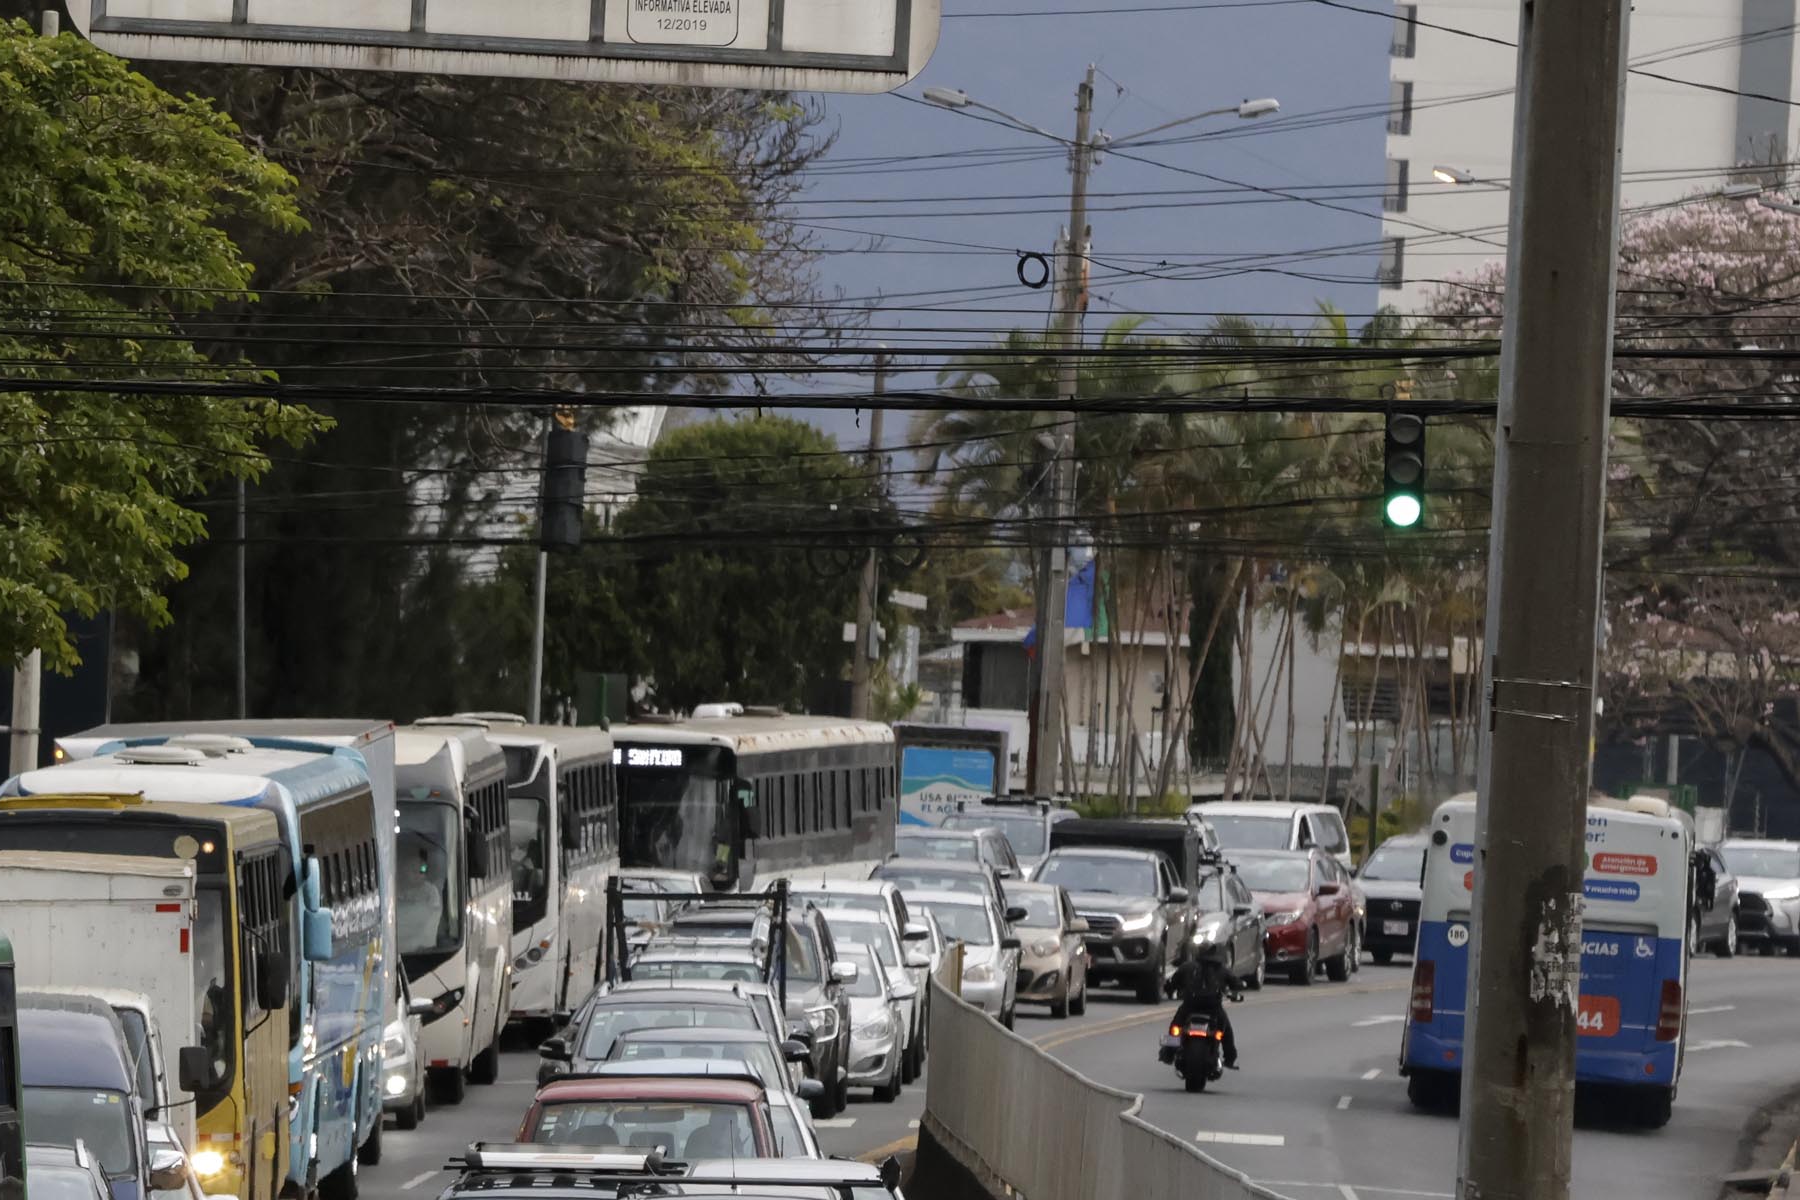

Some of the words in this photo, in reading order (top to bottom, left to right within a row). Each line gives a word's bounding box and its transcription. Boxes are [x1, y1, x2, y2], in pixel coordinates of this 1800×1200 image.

[635, 0, 690, 12] INFORMATIVA
[693, 0, 731, 13] ELEVADA
[657, 19, 707, 30] 12/2019
[1580, 941, 1619, 955] NCIAS
[1577, 1010, 1604, 1031] 44
